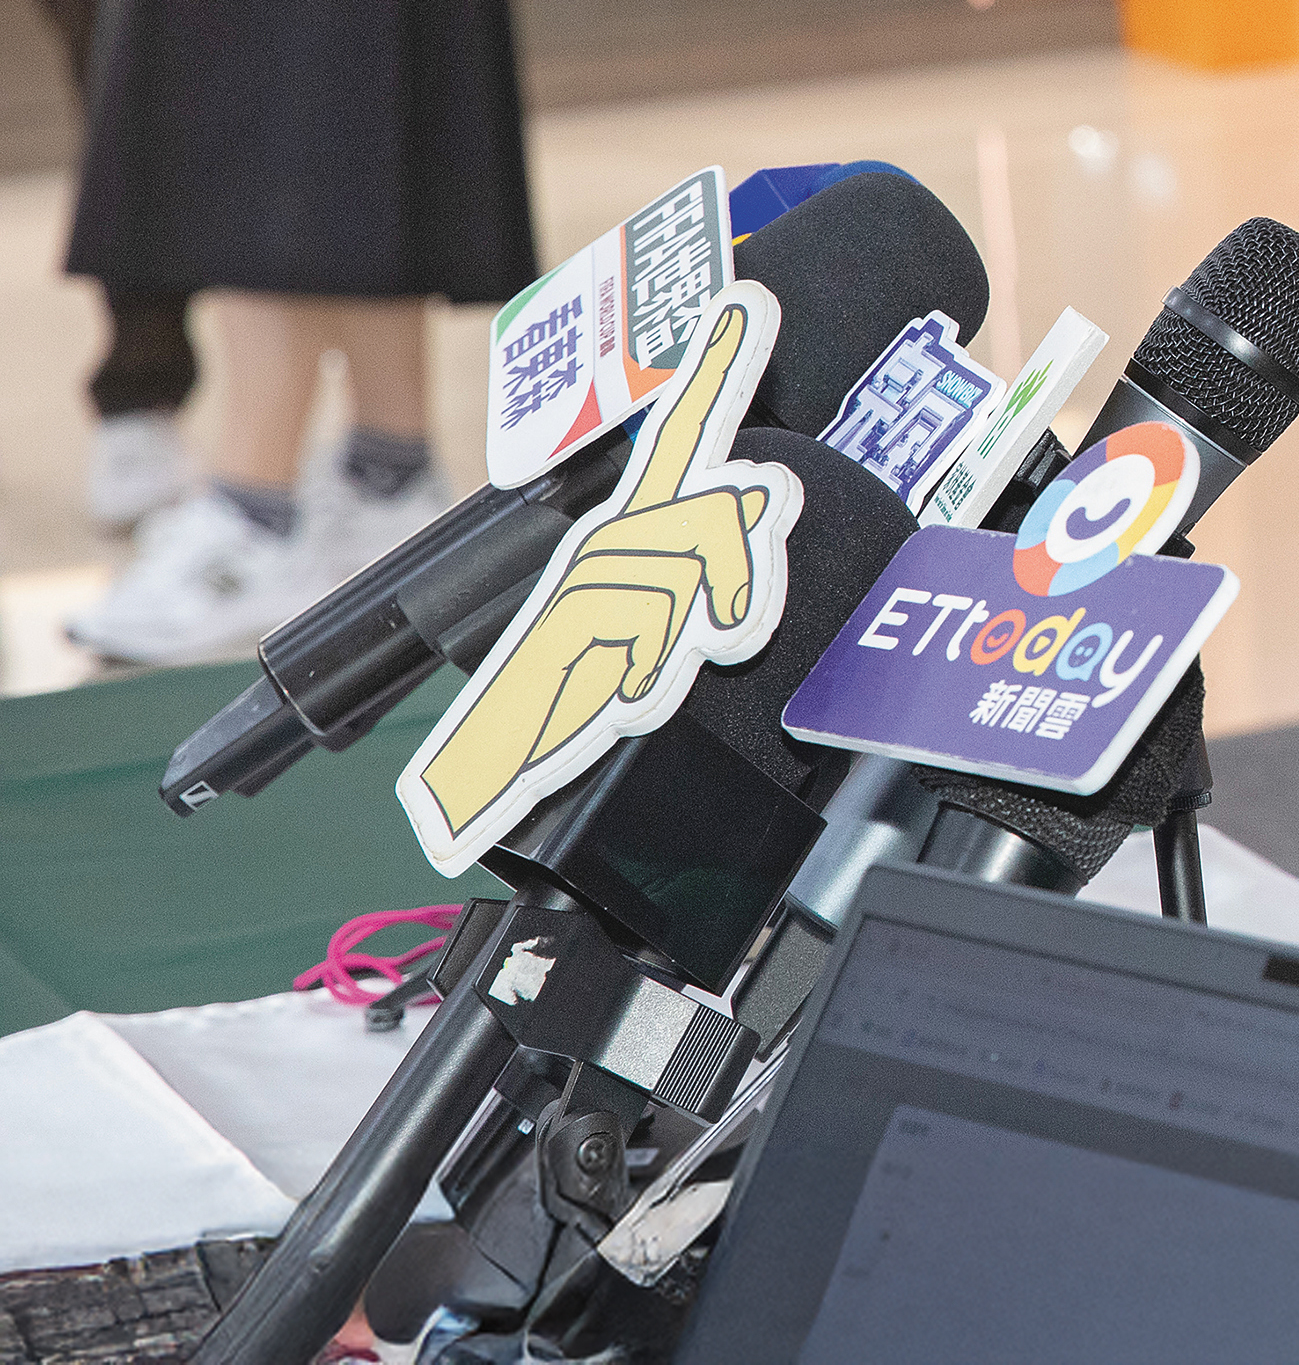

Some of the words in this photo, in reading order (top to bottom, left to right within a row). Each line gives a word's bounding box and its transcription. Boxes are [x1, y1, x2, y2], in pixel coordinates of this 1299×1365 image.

[600, 291, 615, 325] WORLD
[632, 181, 711, 370] FIFA世界盃
[500, 294, 583, 432] 看東森
[936, 370, 984, 409] SHOWBIZ
[857, 587, 1164, 709] ETtoday
[969, 679, 1091, 740] 新聞雲
